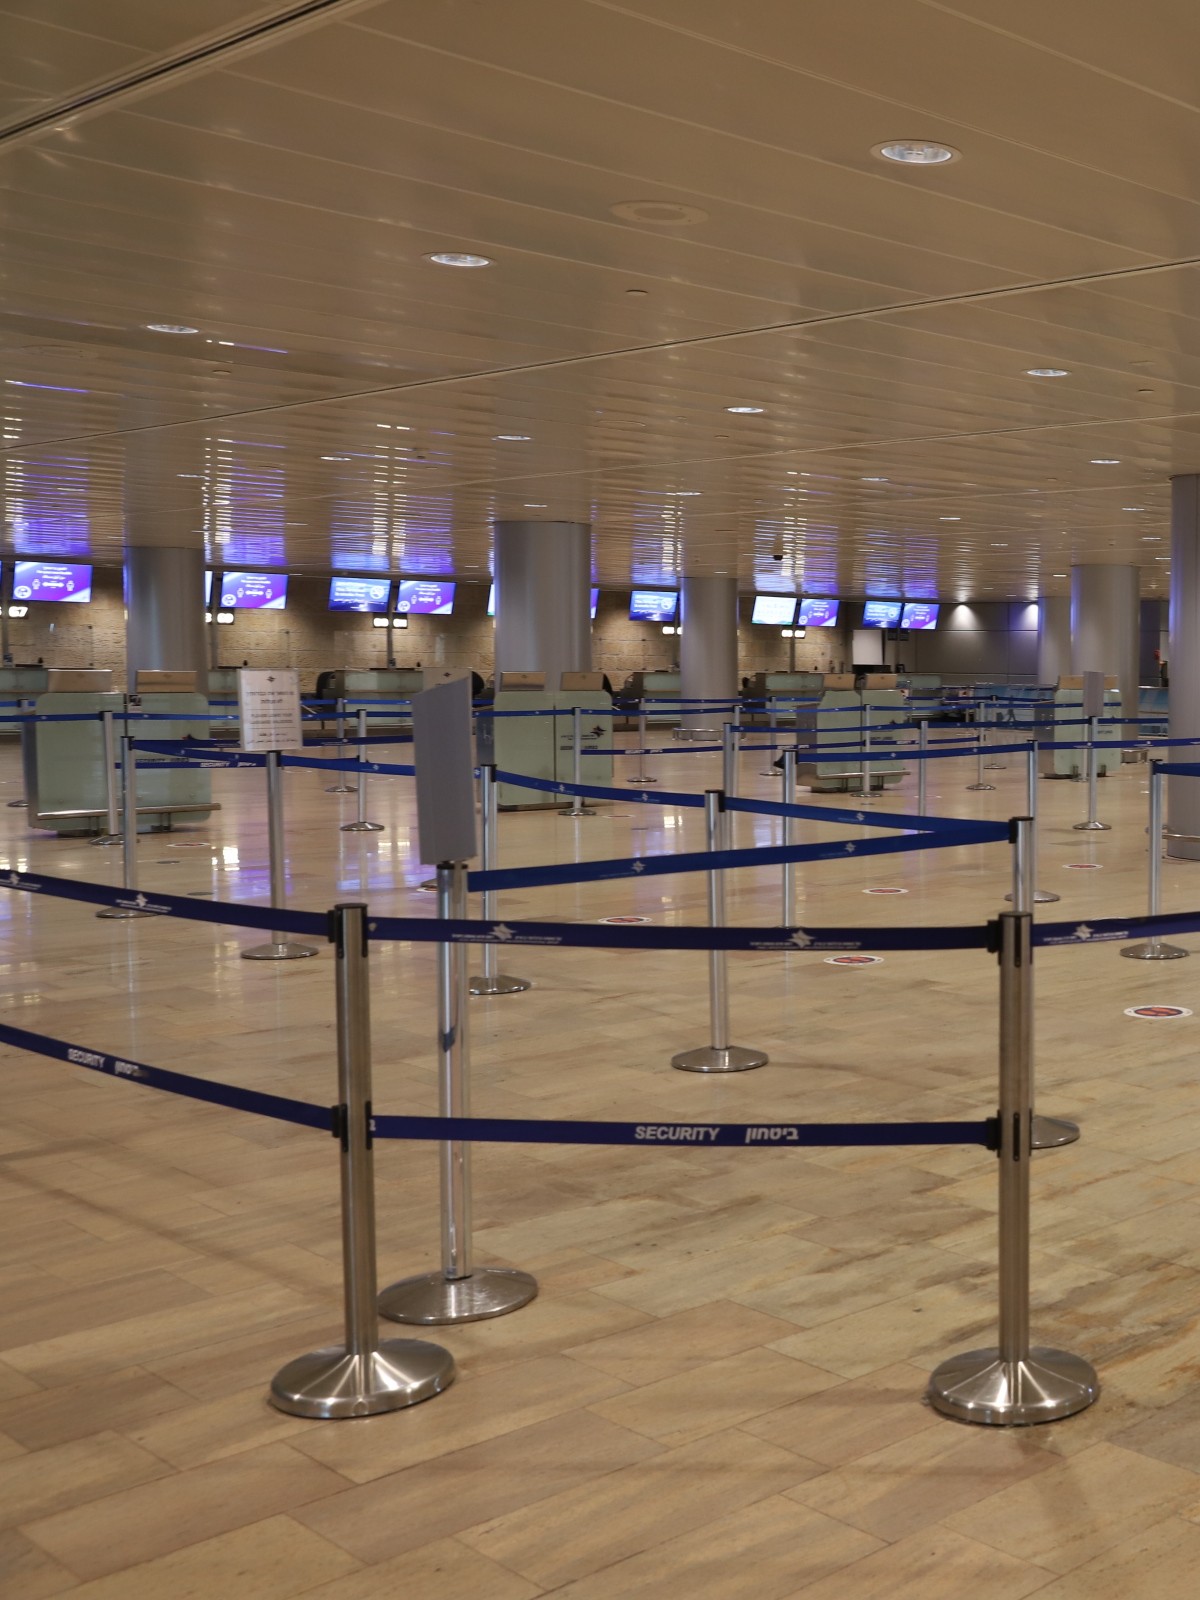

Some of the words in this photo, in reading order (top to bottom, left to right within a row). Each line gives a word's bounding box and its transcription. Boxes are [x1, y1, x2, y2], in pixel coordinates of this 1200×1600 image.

[68, 1048, 106, 1069] SECURITY
[635, 1126, 720, 1140] SECURITY
[745, 1127, 799, 1143] ביטחון
